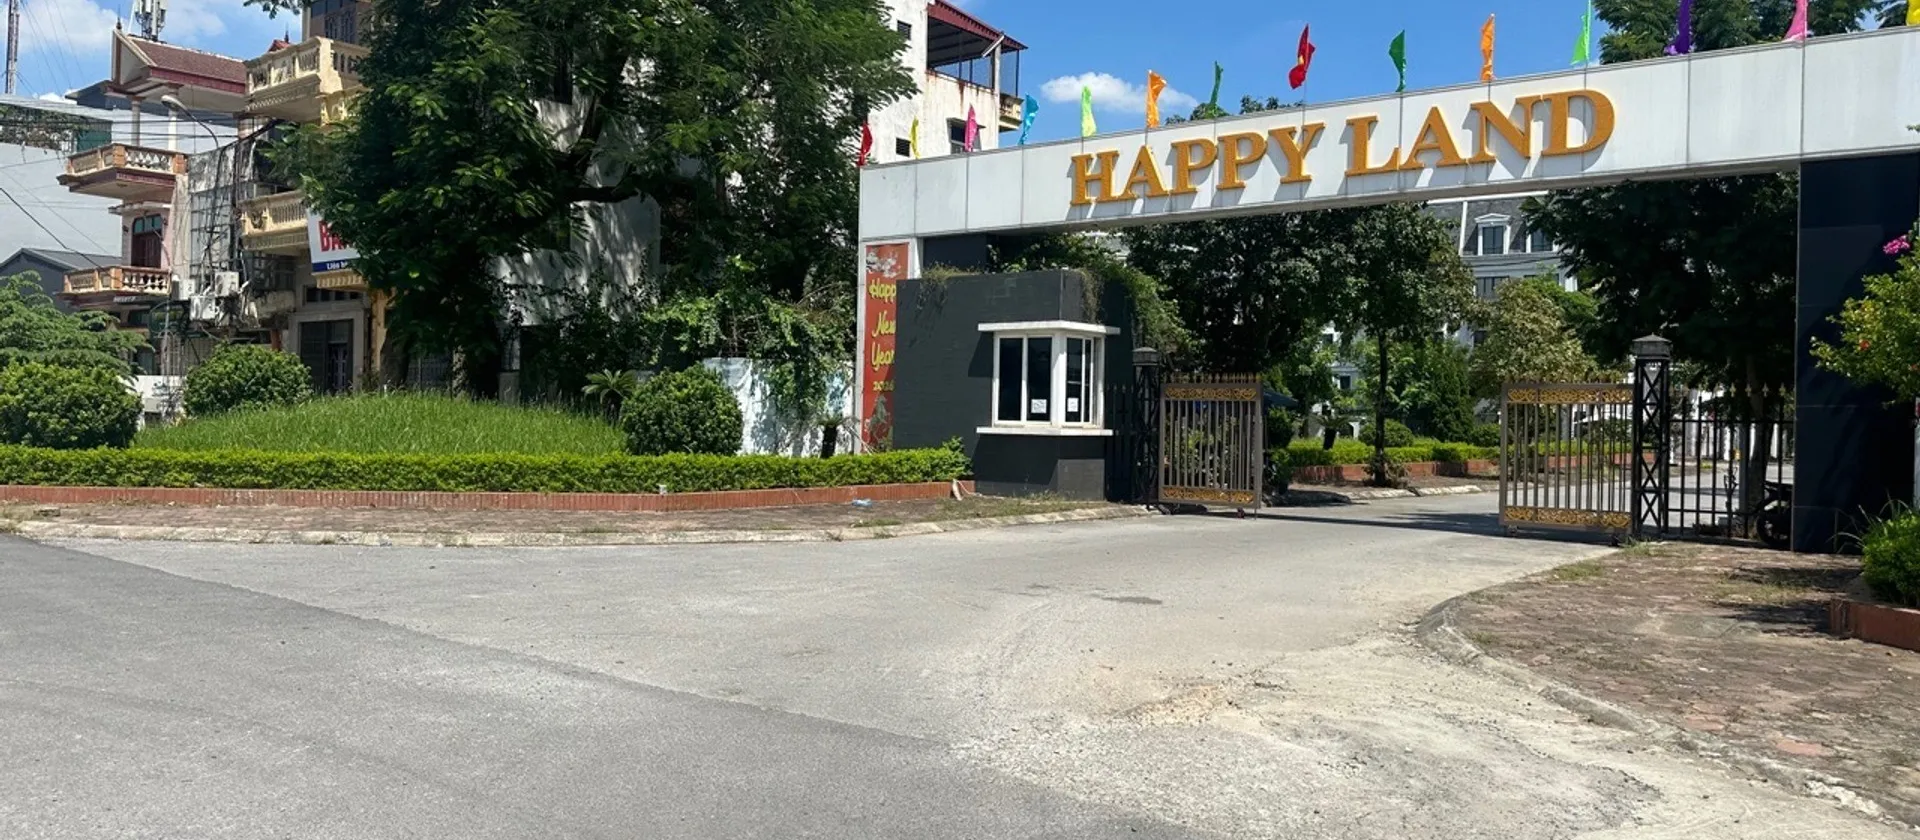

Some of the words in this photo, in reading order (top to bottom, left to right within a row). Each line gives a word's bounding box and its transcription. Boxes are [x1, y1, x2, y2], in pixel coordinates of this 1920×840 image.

[1070, 122, 1326, 205] HAPPY
[1345, 88, 1616, 177] LAND
[868, 277, 897, 303] Happ
